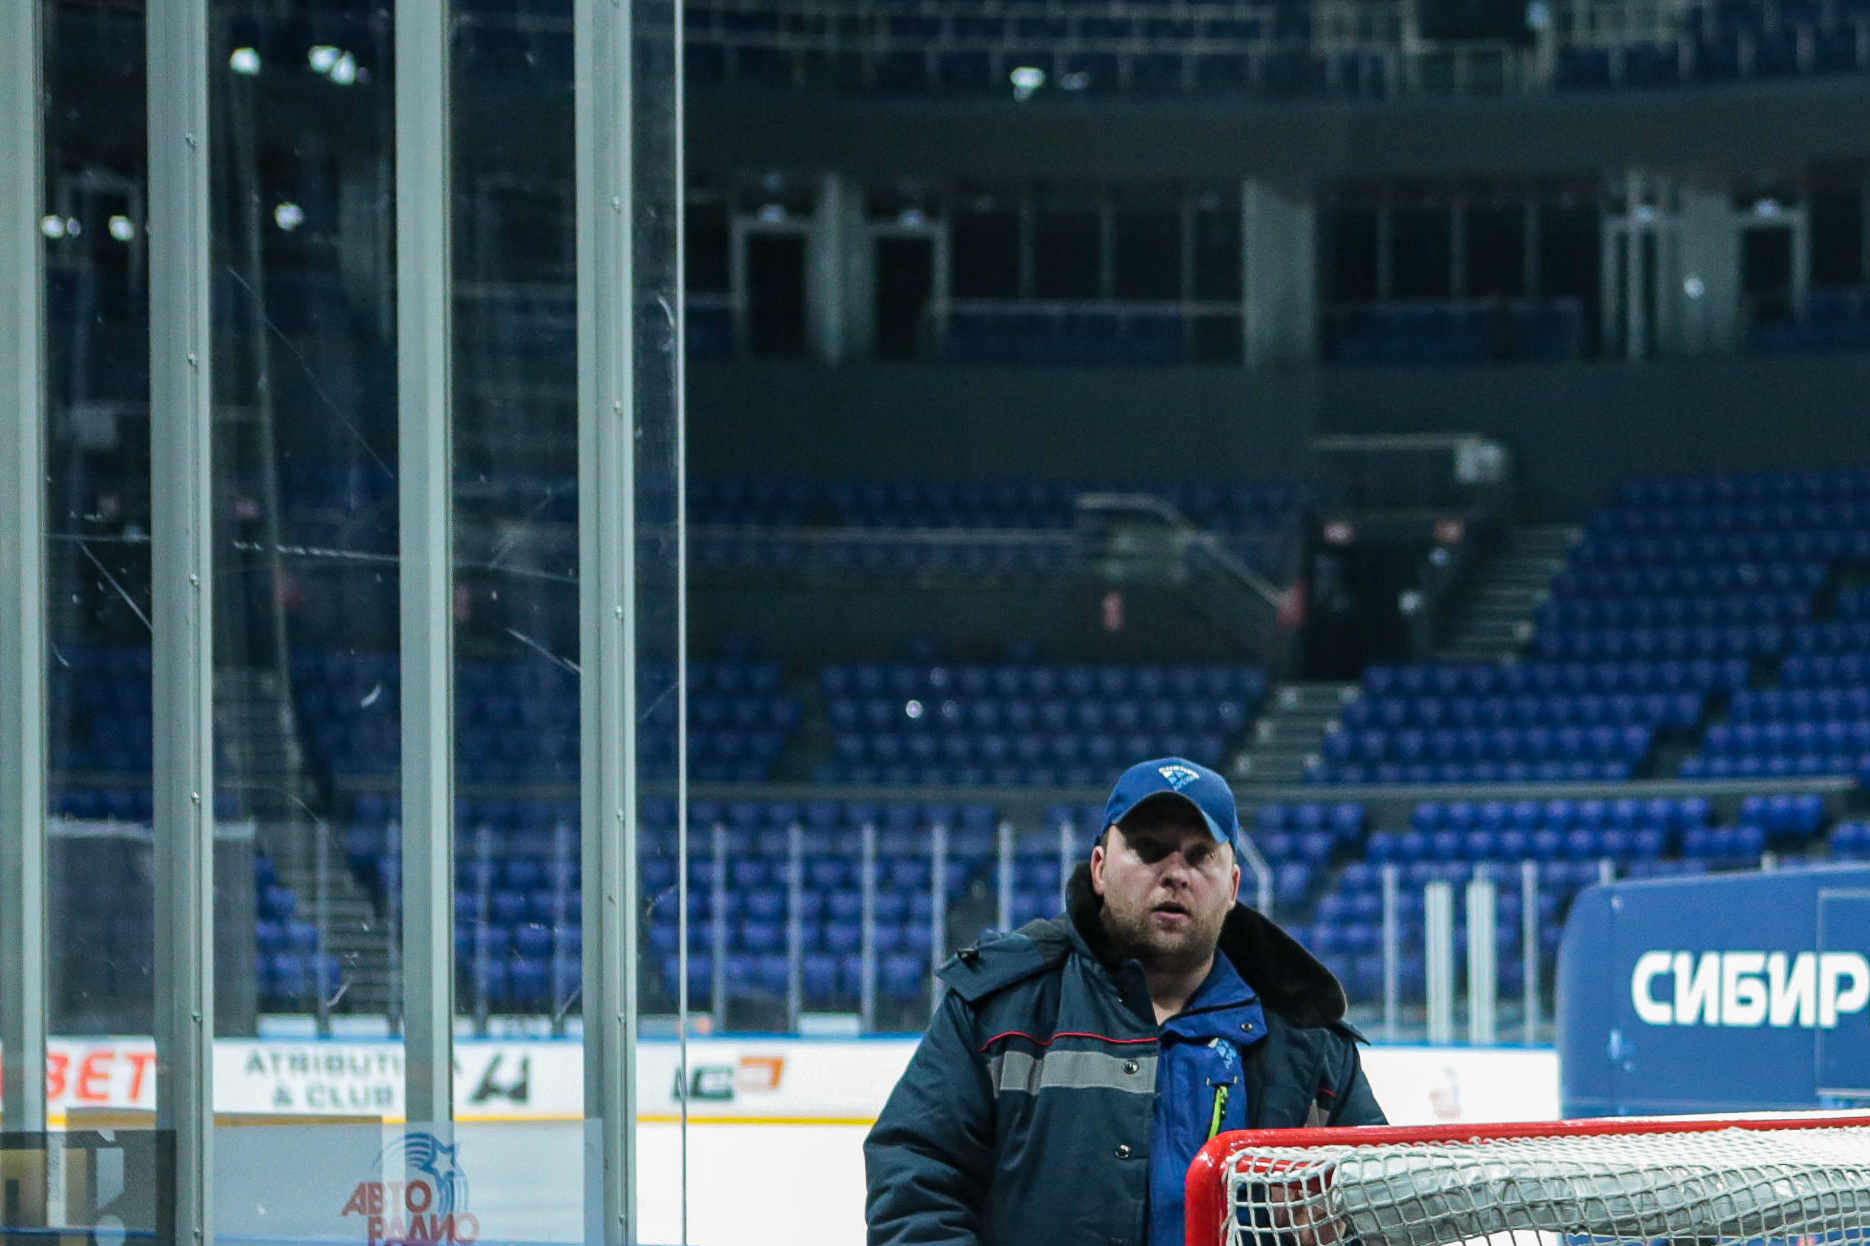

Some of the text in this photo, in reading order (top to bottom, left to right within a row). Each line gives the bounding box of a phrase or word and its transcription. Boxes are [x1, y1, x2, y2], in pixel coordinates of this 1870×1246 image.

[0, 1051, 157, 1102] BET
[245, 1051, 461, 1075] ATRIBUTI
[341, 1179, 433, 1217] АВТО
